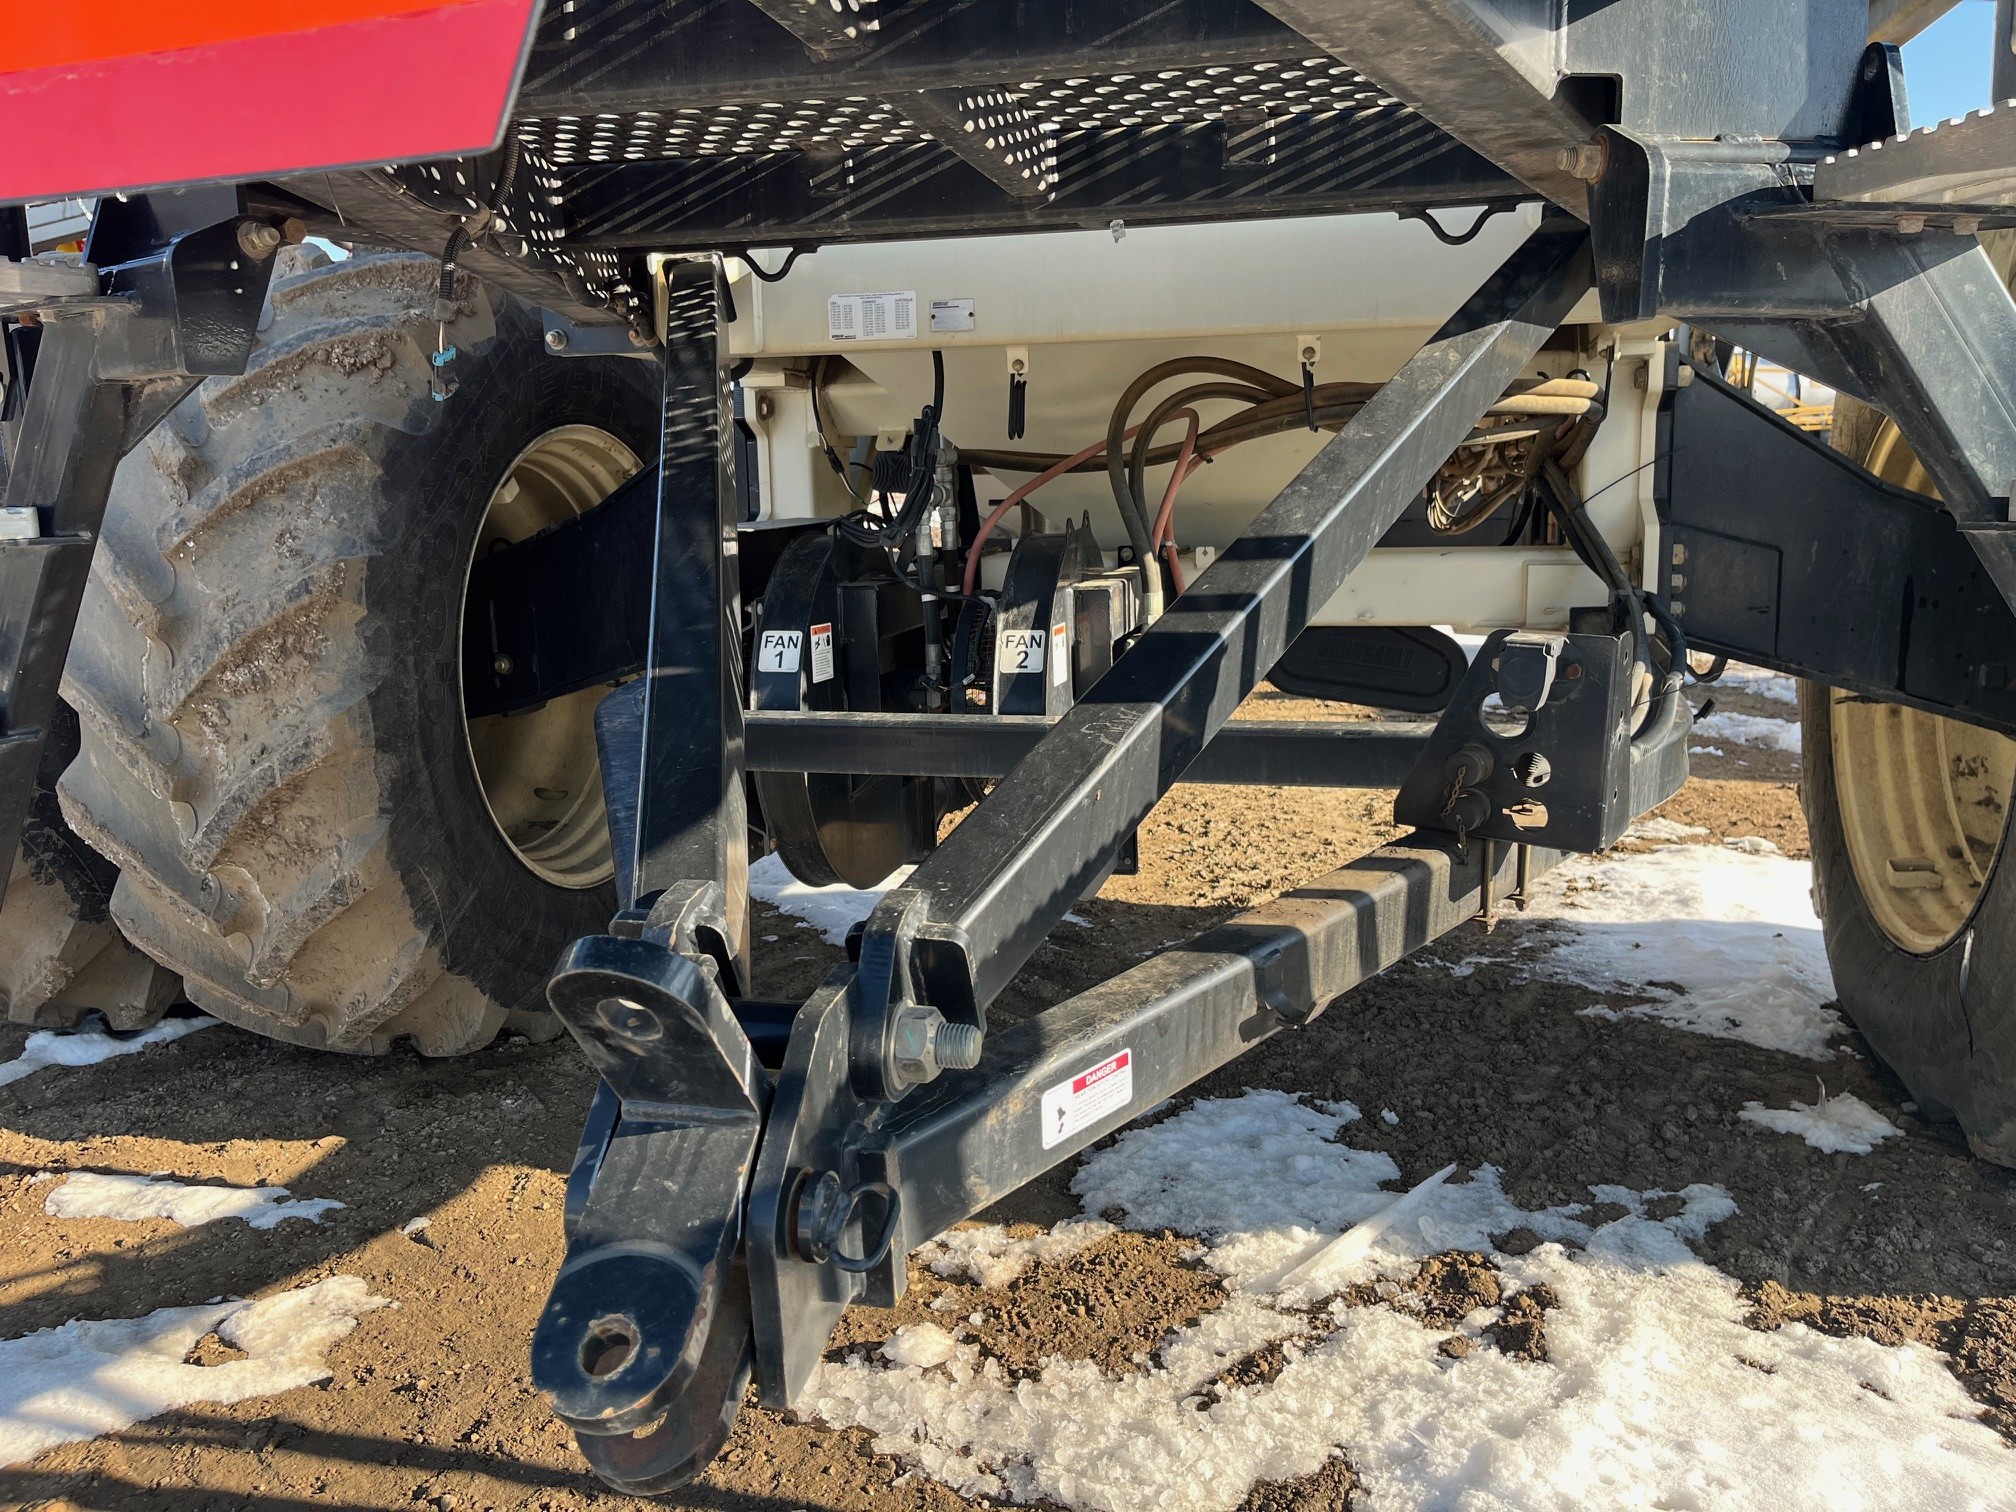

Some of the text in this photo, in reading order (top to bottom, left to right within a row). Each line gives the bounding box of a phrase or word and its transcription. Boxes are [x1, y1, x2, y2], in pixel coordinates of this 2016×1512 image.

[764, 635, 799, 649] FAN
[1006, 634, 1042, 649] FAN
[775, 650, 783, 669] 1
[1015, 650, 1029, 669] 2
[1085, 1061, 1117, 1086] DANGER
